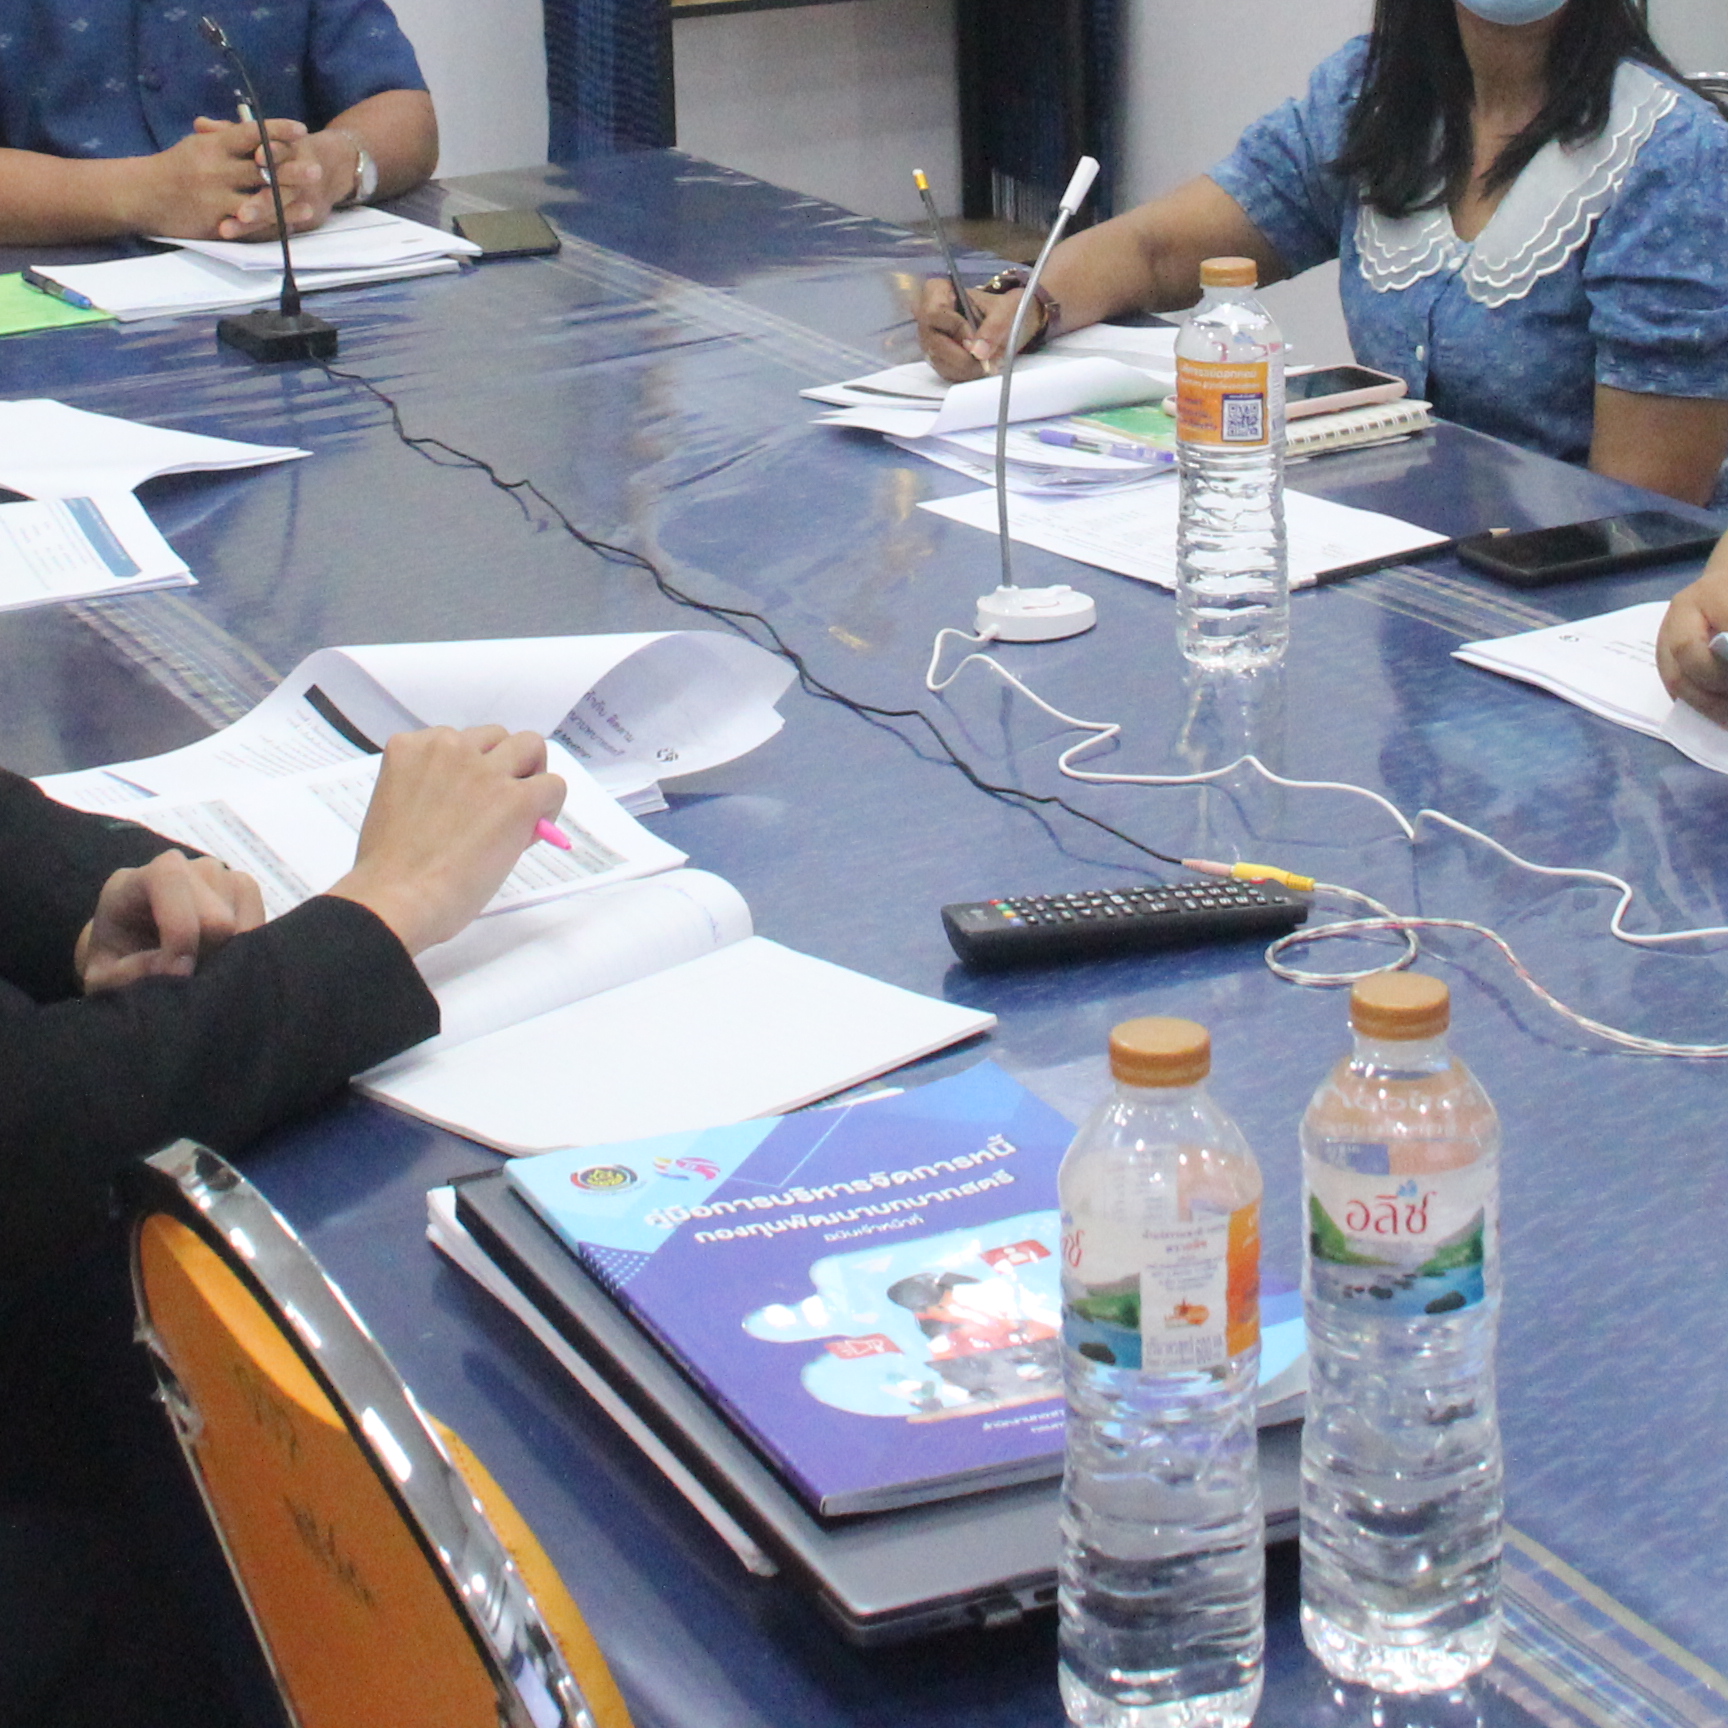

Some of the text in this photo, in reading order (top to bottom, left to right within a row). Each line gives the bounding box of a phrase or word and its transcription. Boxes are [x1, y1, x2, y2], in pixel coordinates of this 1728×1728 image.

[643, 1133, 1018, 1229] คู่มือการบริหารจัดการหนี้
[693, 1169, 1016, 1244] กองทุนพัฒนาบทบาทสตรี
